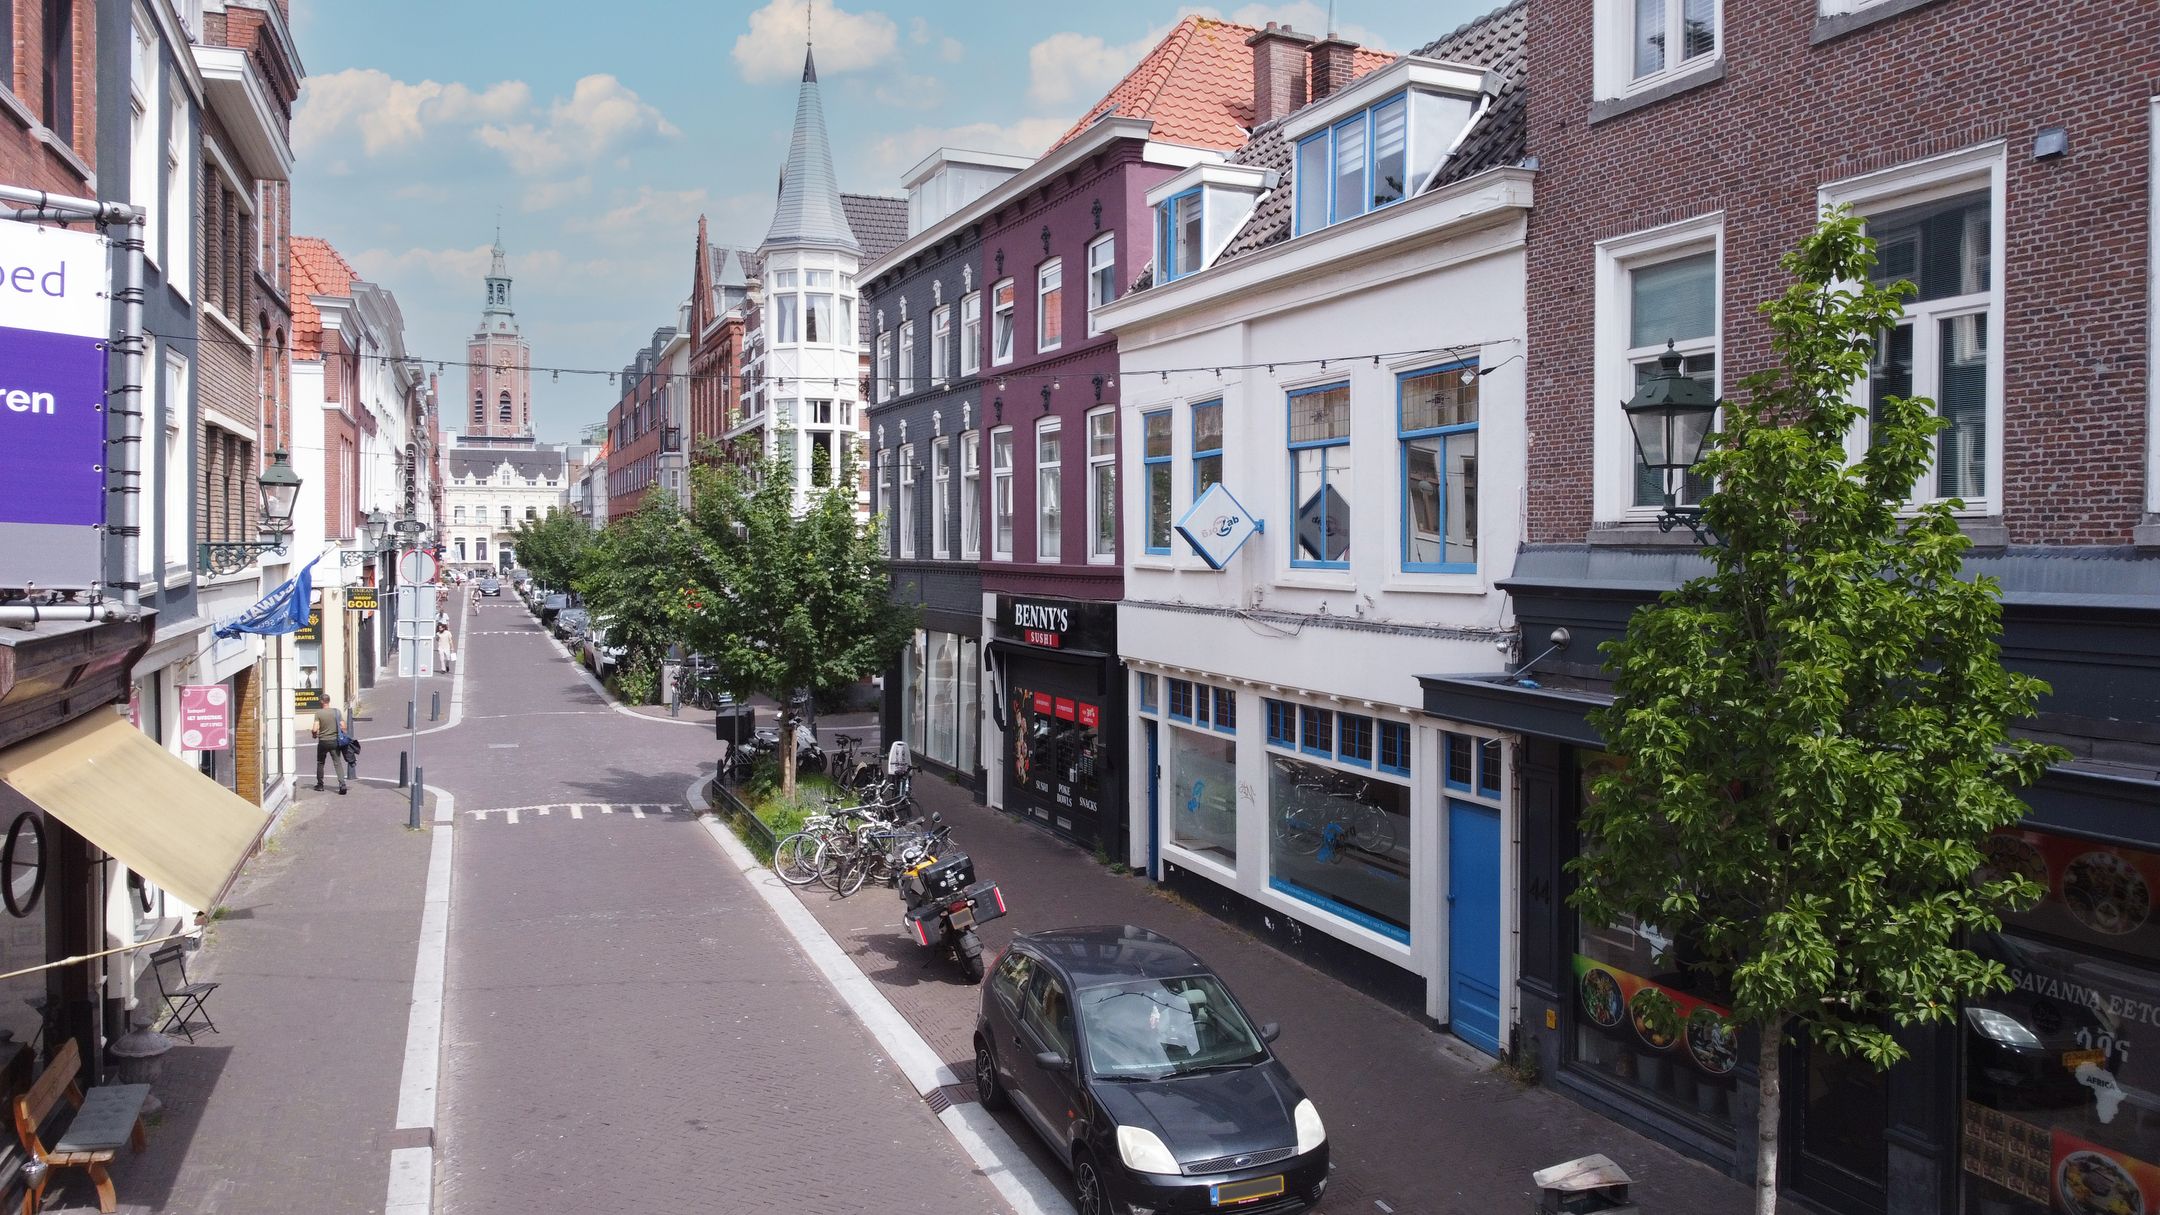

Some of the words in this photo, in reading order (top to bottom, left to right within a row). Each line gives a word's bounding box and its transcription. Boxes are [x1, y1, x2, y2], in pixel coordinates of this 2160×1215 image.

[0, 260, 65, 298] ed
[347, 600, 378, 609] GOUD
[1015, 603, 1068, 632] BENNY'S
[1030, 631, 1053, 646] SUSHI
[1079, 796, 1098, 812] SNACKS
[2011, 968, 2101, 1011] SAVANNA
[2086, 1075, 2115, 1090] AFRICA
